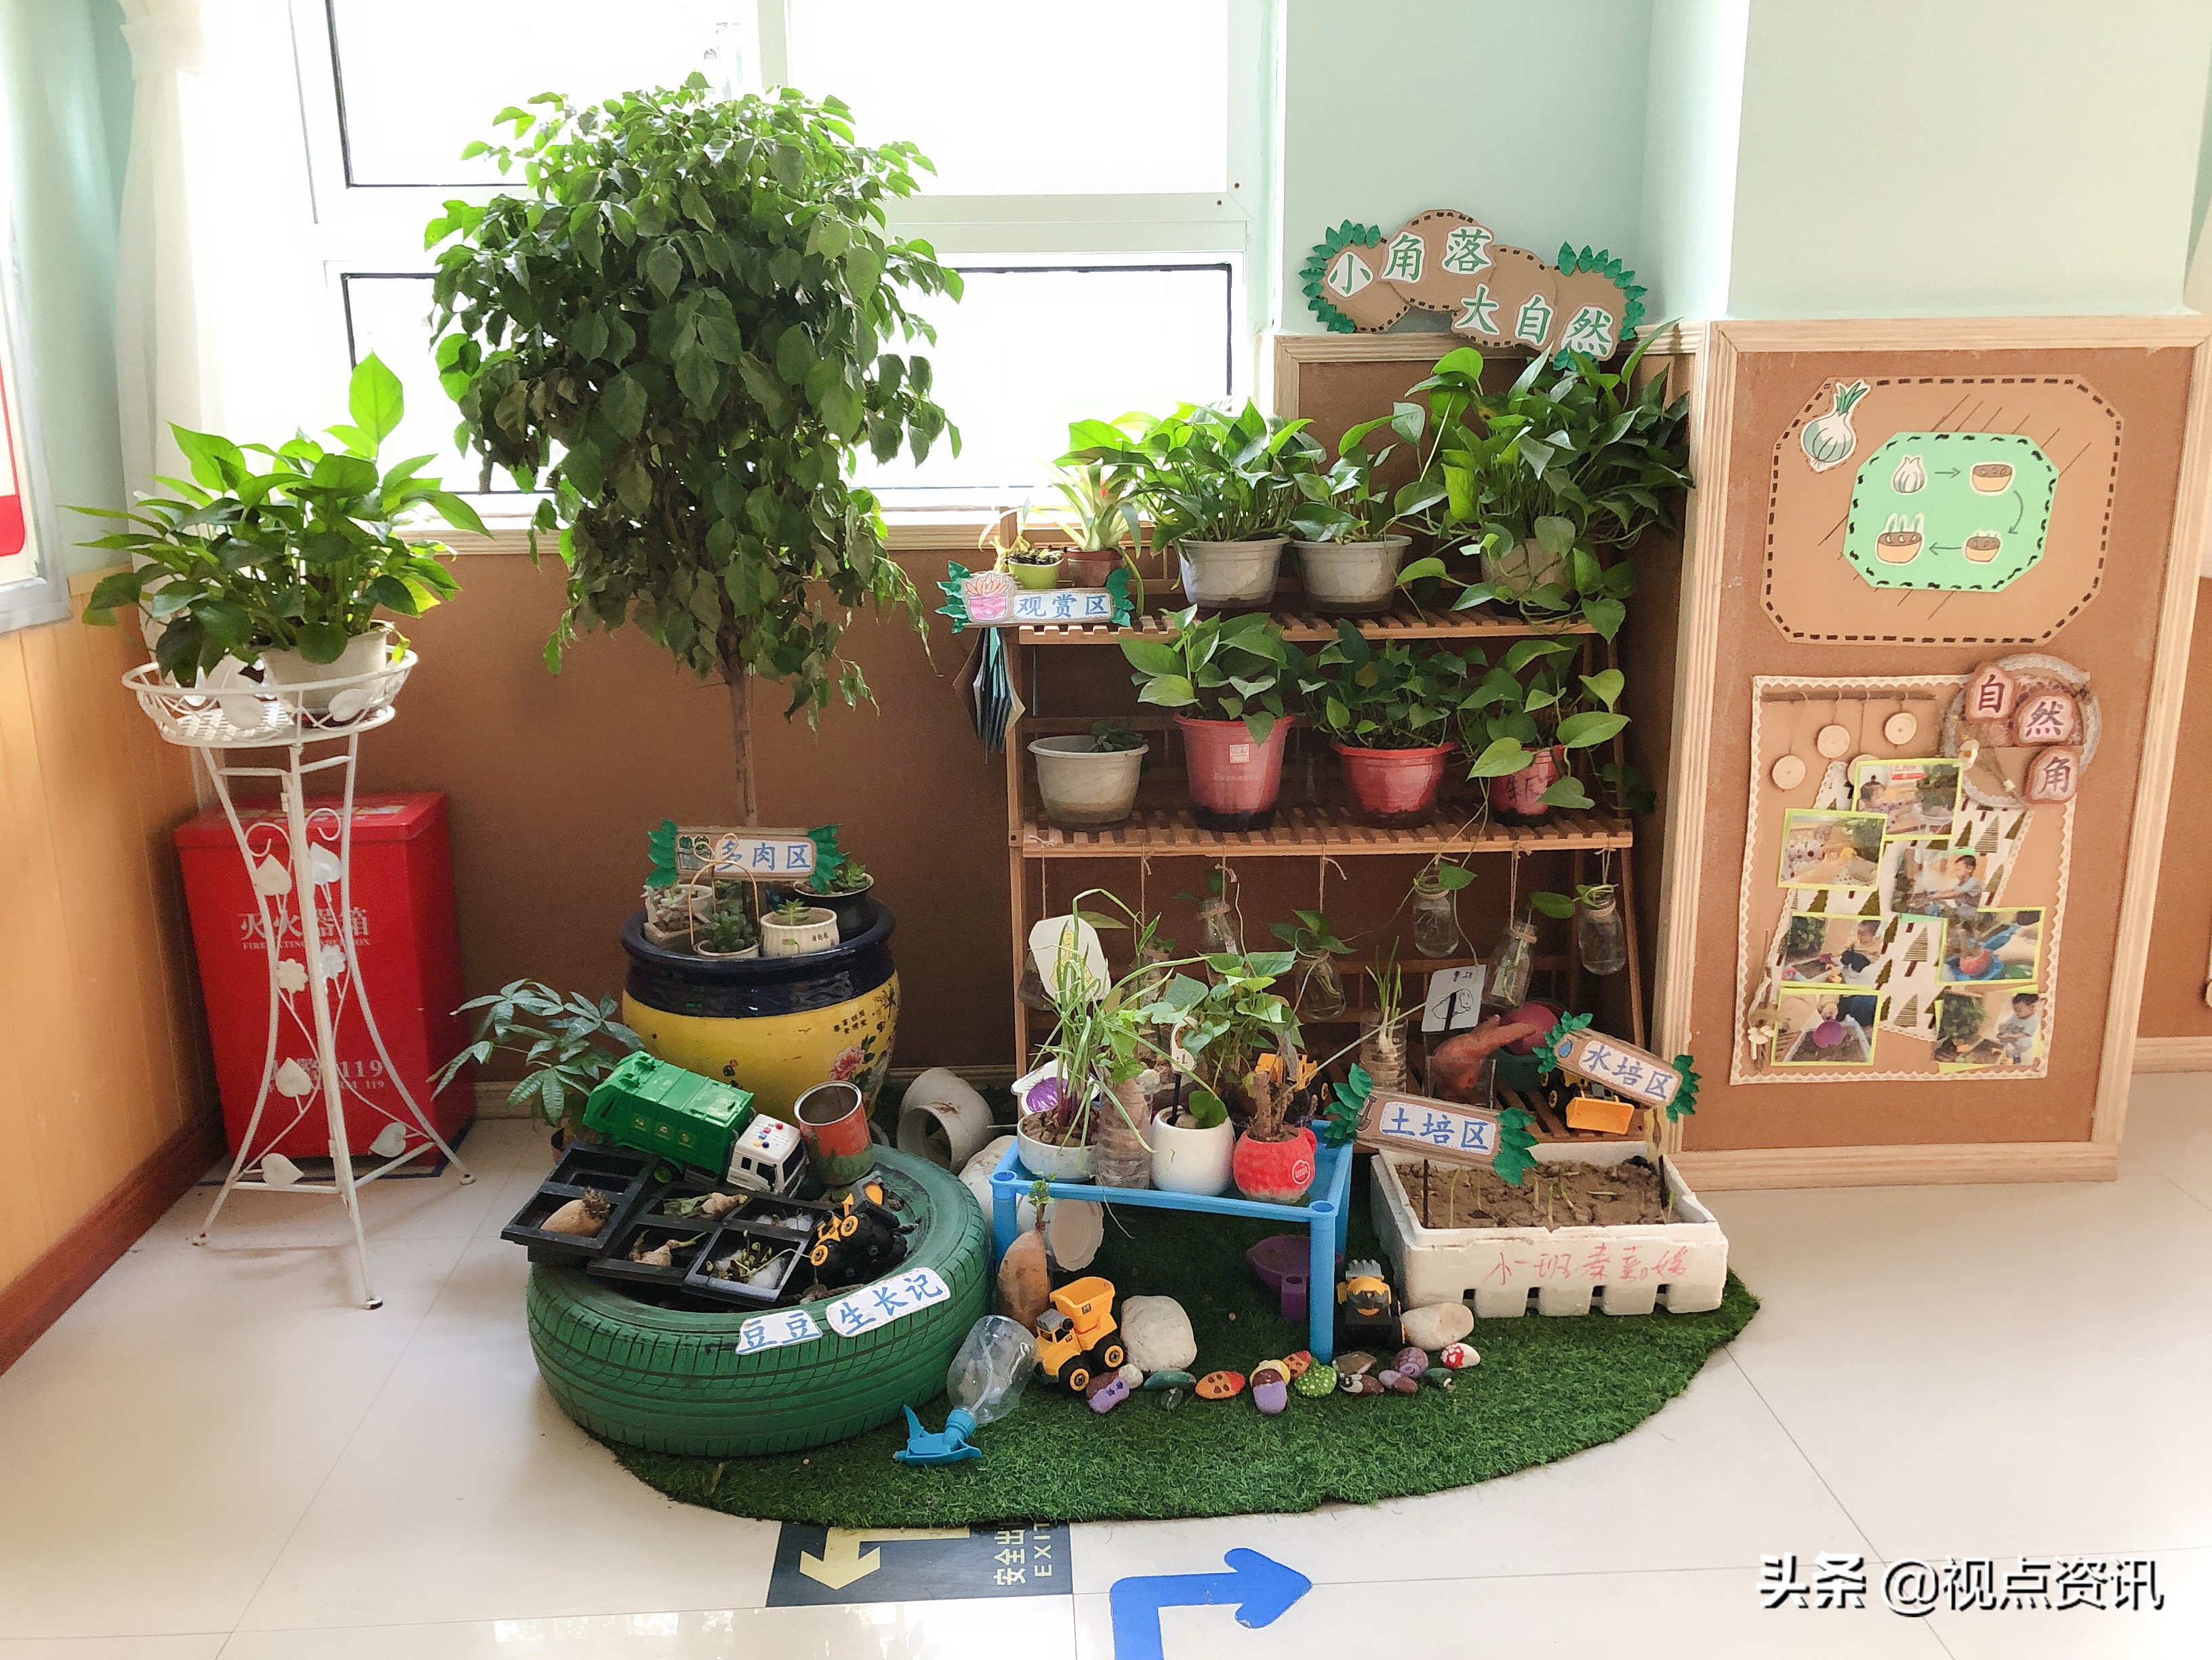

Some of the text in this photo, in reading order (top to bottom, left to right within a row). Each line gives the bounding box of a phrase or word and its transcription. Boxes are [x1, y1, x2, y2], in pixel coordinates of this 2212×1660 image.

[1329, 228, 1490, 296] 小角落
[1455, 286, 1613, 356] 大自然
[1016, 593, 1107, 619] 观赏区
[1977, 673, 2072, 795] 自然角
[717, 839, 811, 871] 多肉区
[1582, 1044, 1673, 1100] 水培区
[1382, 1107, 1489, 1150] 土培区
[738, 1273, 943, 1354] 豆豆 生长记
[992, 1524, 1026, 1585] 安全出
[1033, 1522, 1052, 1577] EXIT
